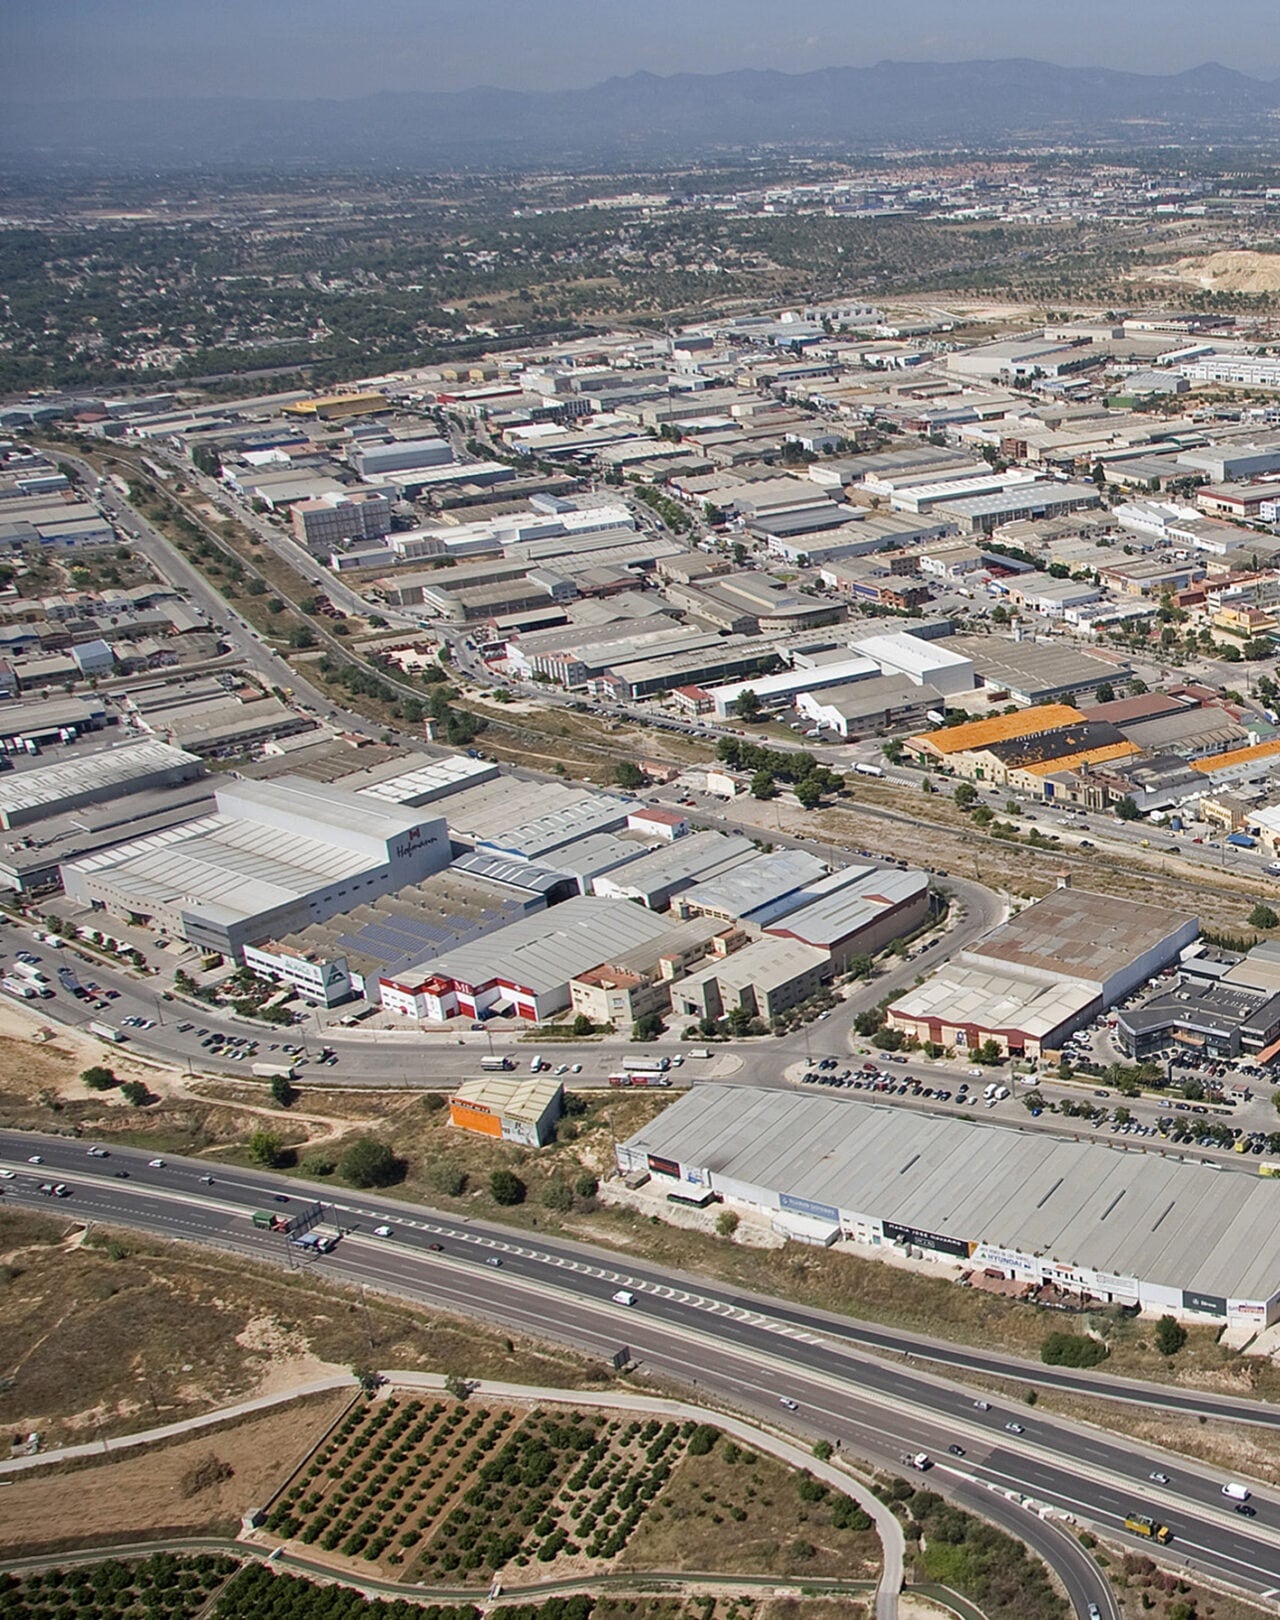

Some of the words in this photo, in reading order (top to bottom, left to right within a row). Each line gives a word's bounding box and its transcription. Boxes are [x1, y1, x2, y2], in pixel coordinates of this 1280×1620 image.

[396, 837, 438, 858] Hofmann
[988, 1253, 1023, 1267] HYUNDAI
[1041, 1267, 1089, 1285] STILL
